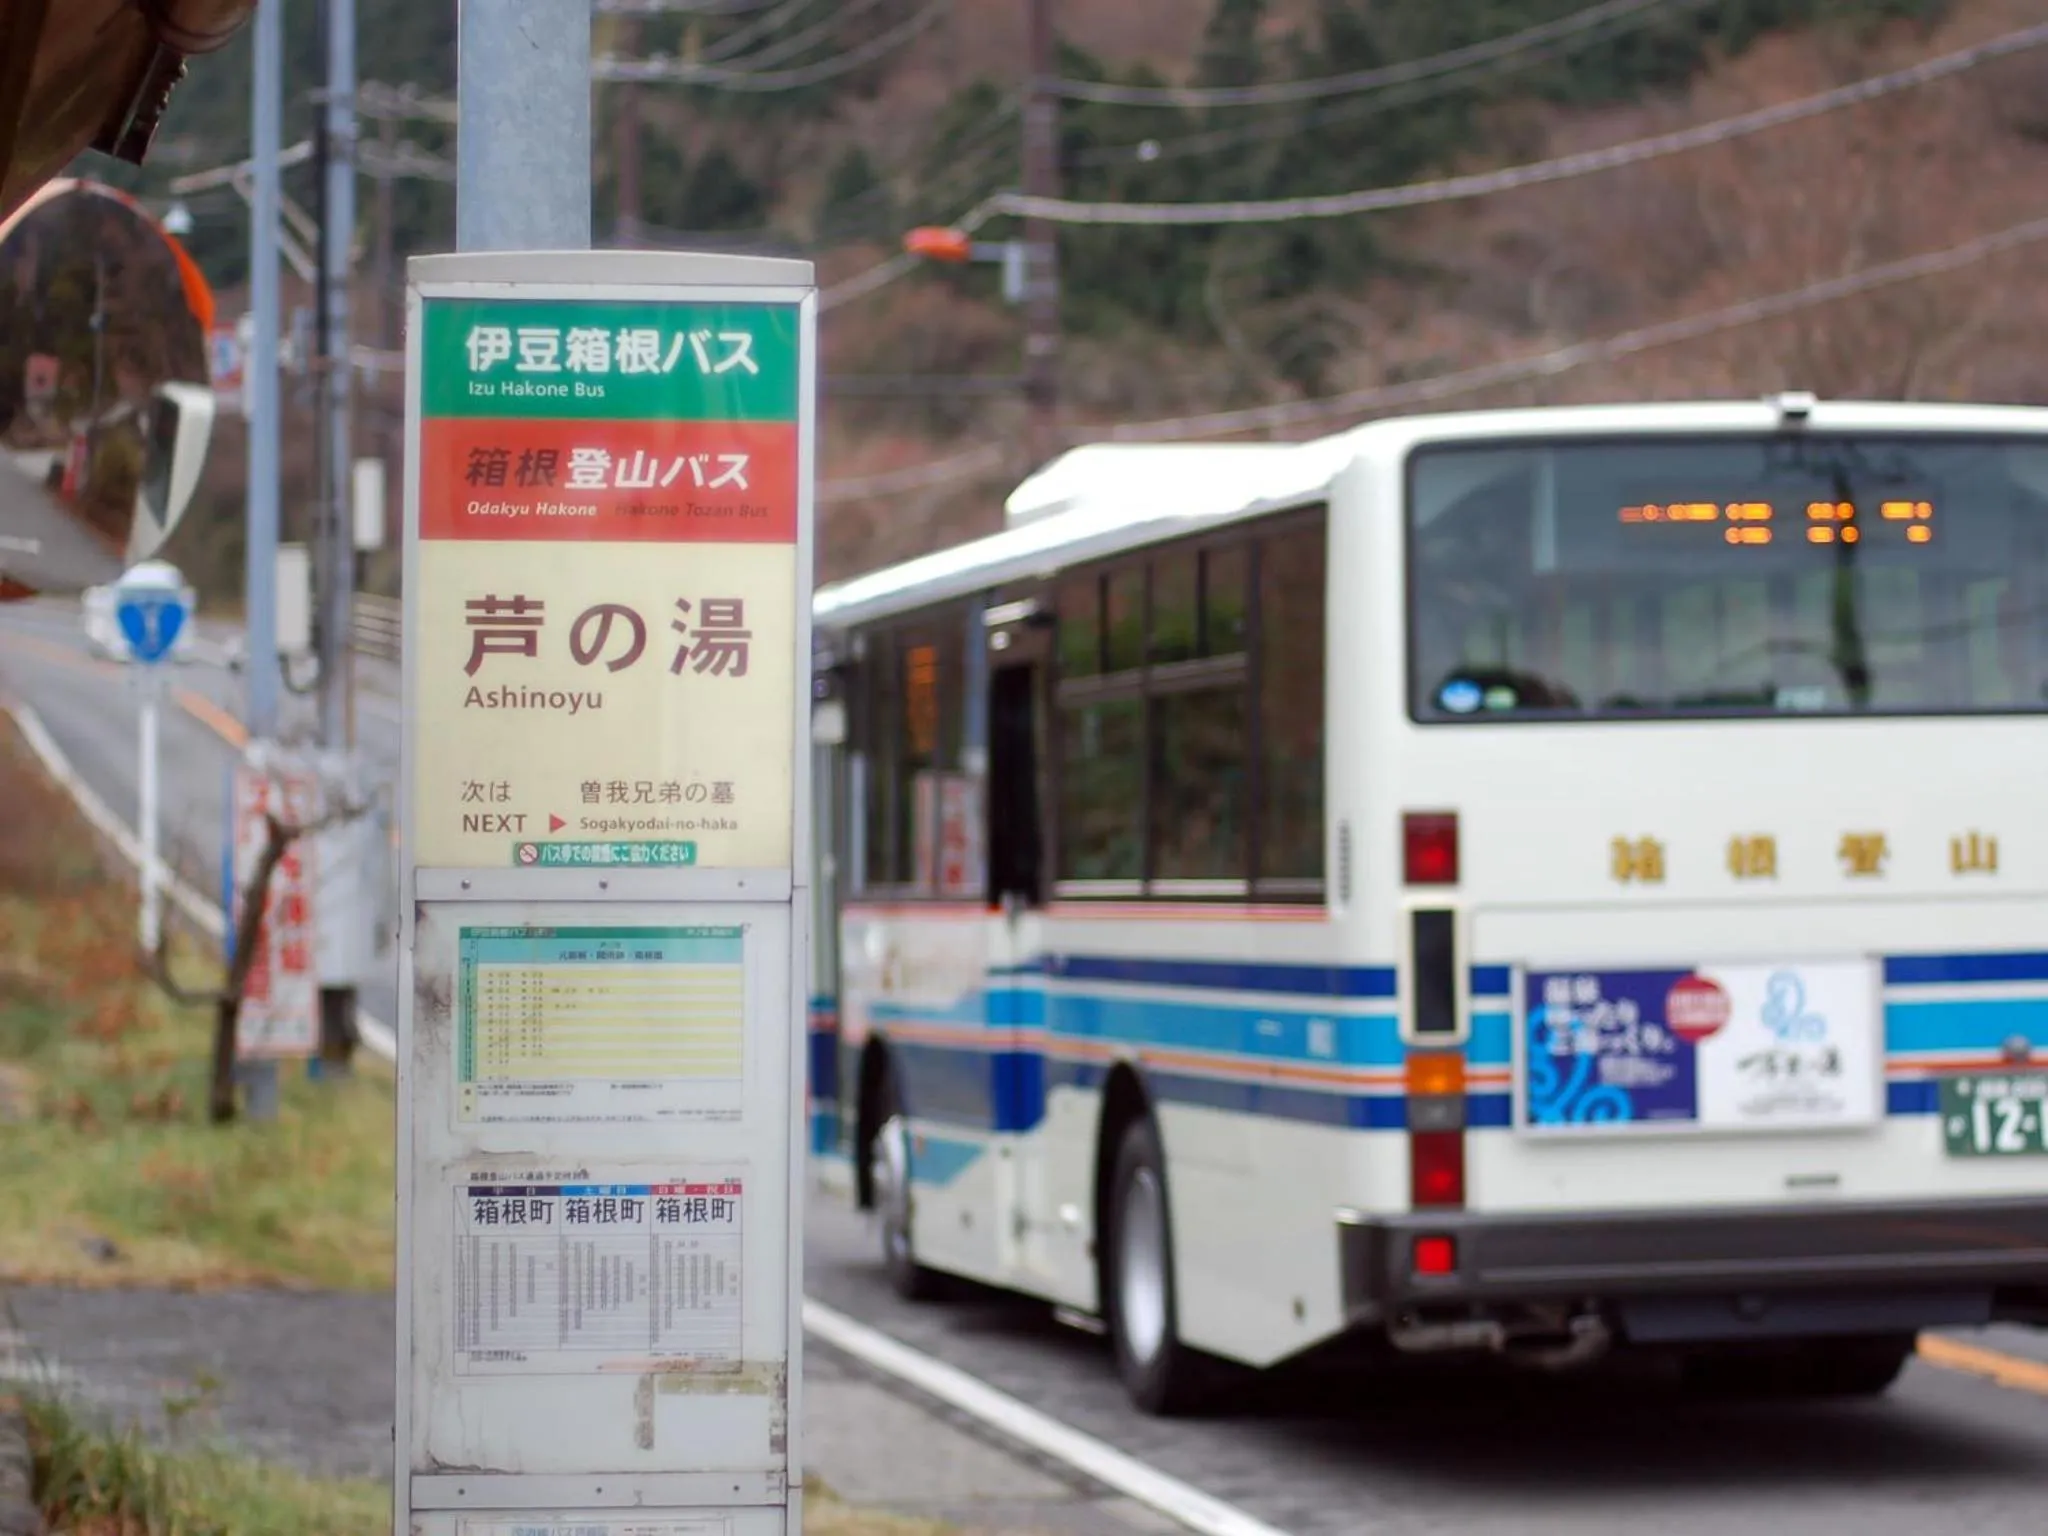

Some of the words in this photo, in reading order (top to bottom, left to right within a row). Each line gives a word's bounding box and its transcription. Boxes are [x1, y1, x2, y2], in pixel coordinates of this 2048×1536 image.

[466, 326, 759, 375] 伊豆箱根バス
[469, 381, 495, 396] Izu
[501, 381, 568, 396] Hakone
[575, 381, 605, 397] Bus
[465, 447, 749, 490] 箱根登山バス
[467, 501, 529, 516] Odakyu
[535, 502, 597, 516] Hakone
[464, 595, 752, 677] 芦の湯
[464, 685, 602, 715] Ashinoyu
[461, 781, 511, 803] 次は
[580, 781, 735, 805] 曽我兄弟の墓
[463, 814, 527, 833] NEXT
[580, 816, 738, 833] Sogakyodai-no-haka
[474, 1199, 553, 1225] 箱根町
[566, 1198, 644, 1224] 箱根町
[656, 1198, 735, 1224] 箱根町
